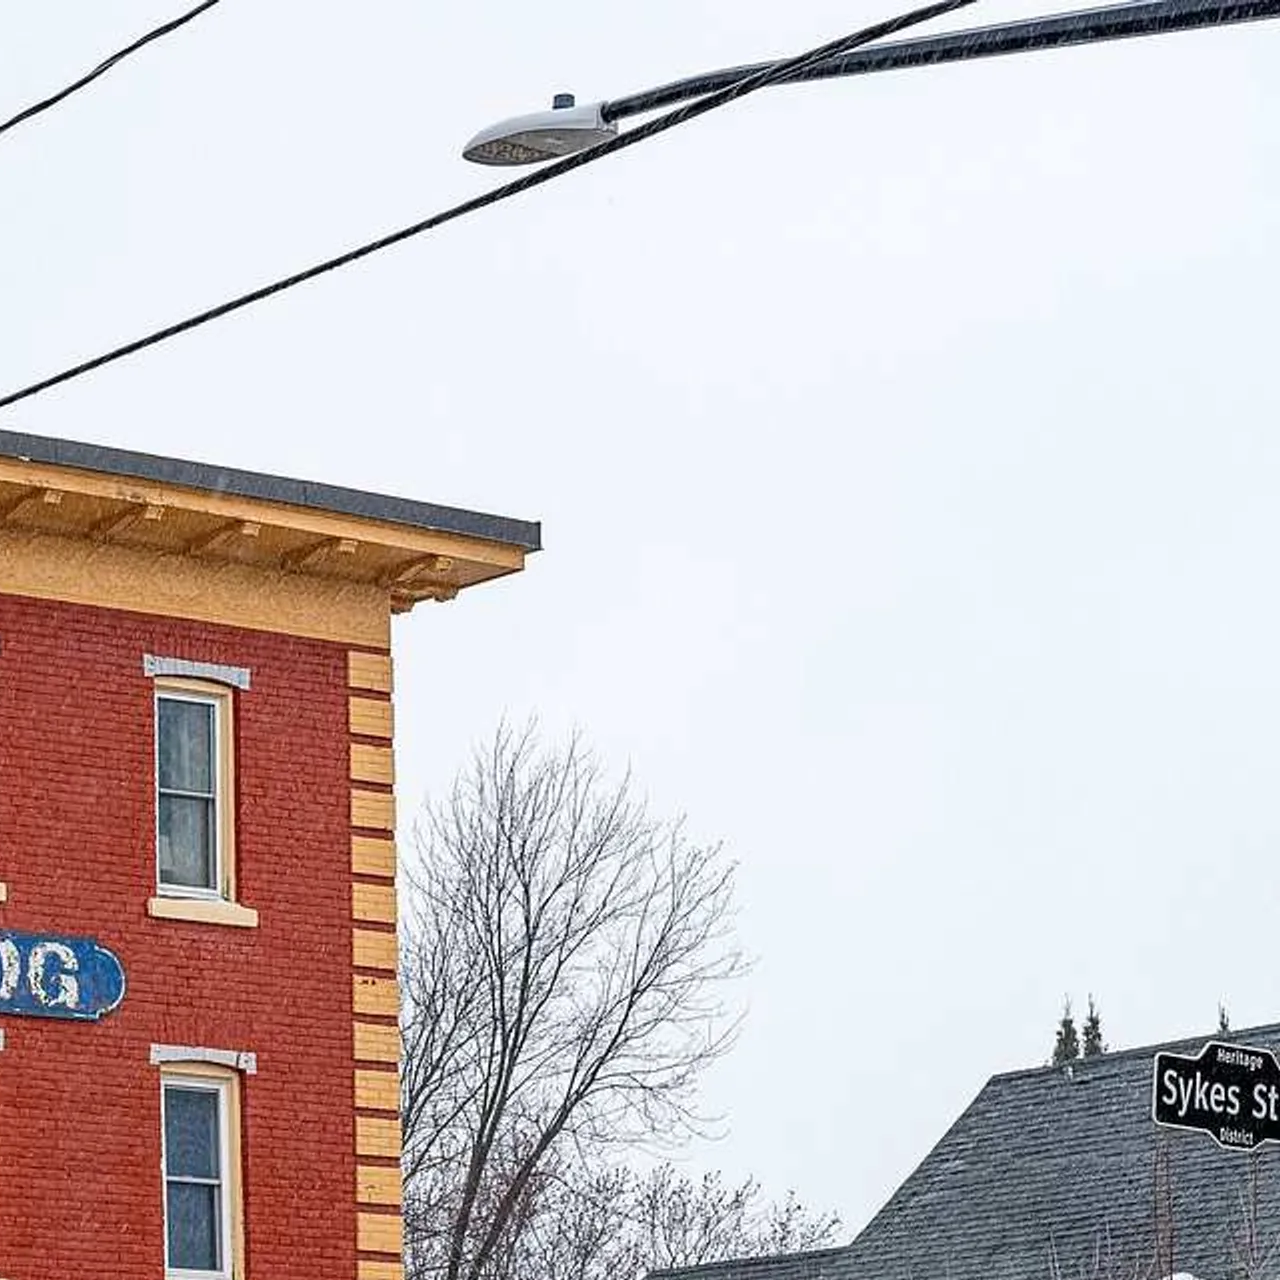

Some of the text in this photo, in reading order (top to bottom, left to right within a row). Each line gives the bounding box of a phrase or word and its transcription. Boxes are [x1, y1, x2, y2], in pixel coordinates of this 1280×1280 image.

[1217, 1047, 1264, 1072] Heritage
[1162, 1069, 1280, 1121] Sykes St
[1220, 1127, 1253, 1145] District
